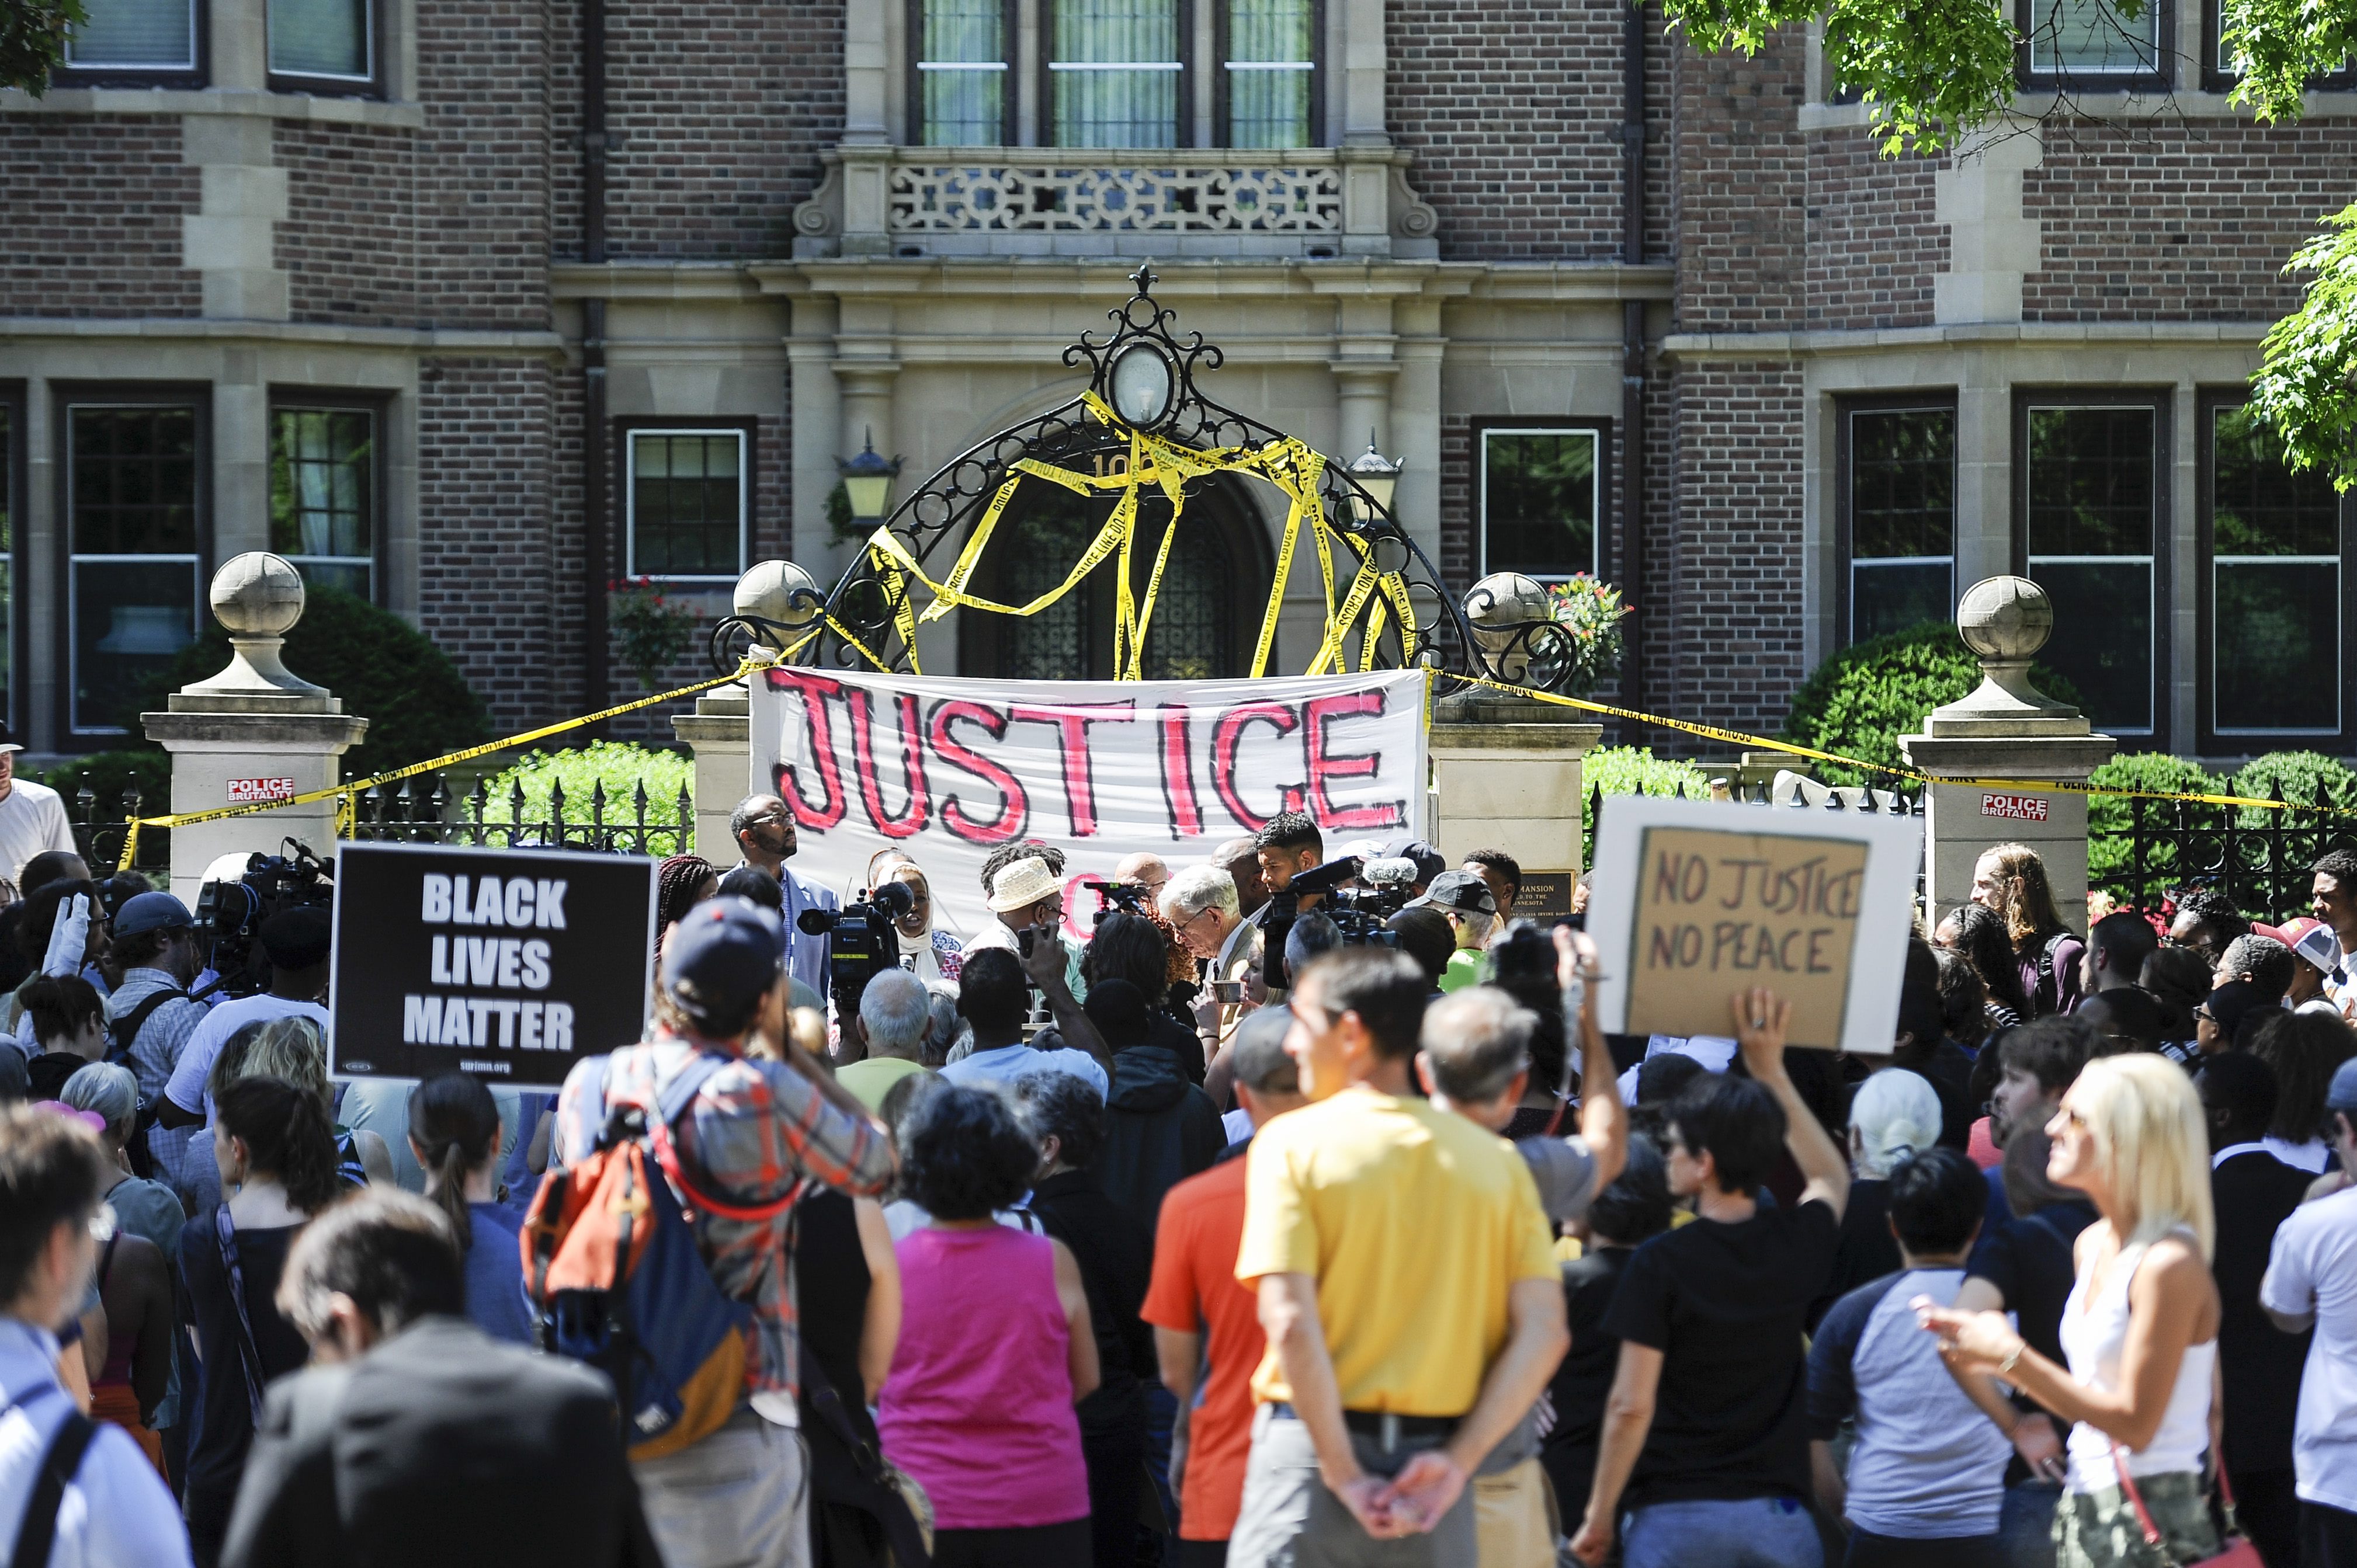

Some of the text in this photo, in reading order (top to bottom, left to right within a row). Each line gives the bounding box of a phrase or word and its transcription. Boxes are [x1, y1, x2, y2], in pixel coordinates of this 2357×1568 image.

[1095, 531, 1118, 554] LINE
[1355, 573, 1373, 596] NOT
[1338, 594, 1363, 629] CROSS
[1692, 724, 1712, 734] NOT
[766, 666, 1408, 845] JUSTICE
[228, 778, 293, 792] POLICE
[228, 790, 292, 801] BRUTALITY
[1981, 806, 2047, 820] BRUTALITY
[1983, 794, 2048, 812] POLICE
[1654, 851, 1865, 919] NO JUSTICE
[422, 874, 568, 929] BLACK
[431, 935, 551, 989] LIVES
[1648, 922, 1835, 974] NO PEACE
[404, 995, 574, 1050] MATTER
